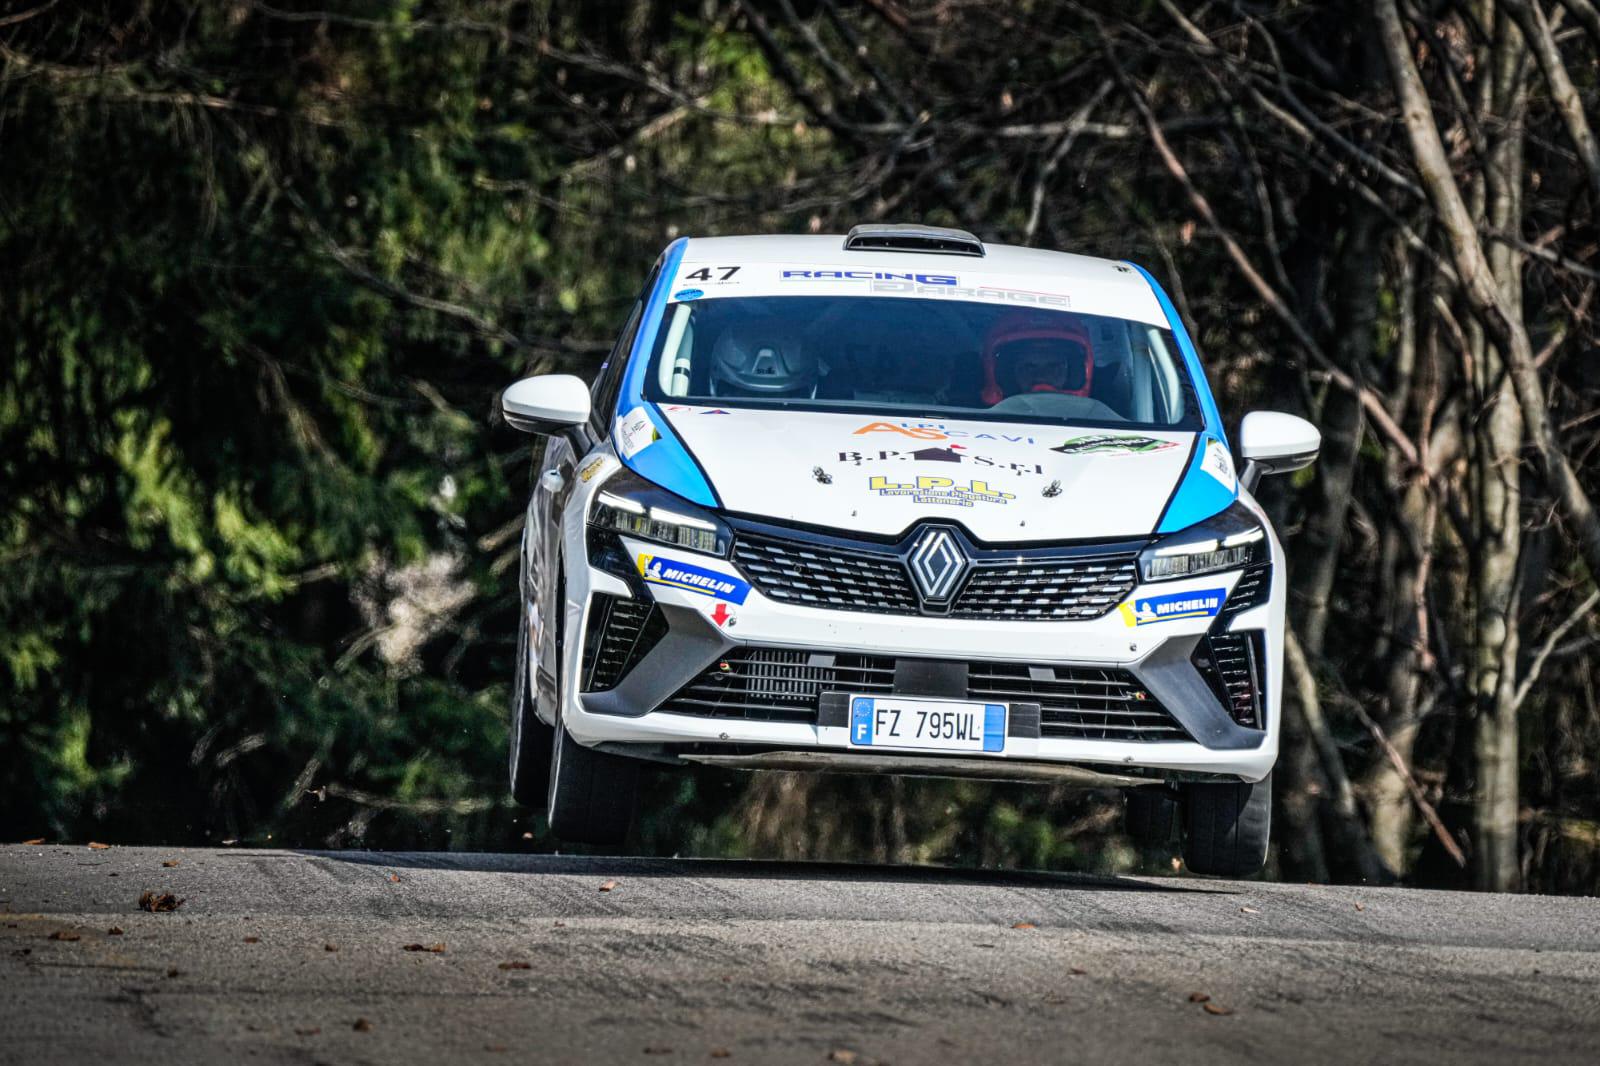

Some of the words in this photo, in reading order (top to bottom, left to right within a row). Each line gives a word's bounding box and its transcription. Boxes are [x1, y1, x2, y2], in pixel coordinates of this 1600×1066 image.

[685, 266, 741, 281] 47
[783, 270, 957, 286] RACING
[663, 568, 735, 594] MICHELIN
[1156, 597, 1218, 614] MICHELIN
[857, 724, 867, 740] F
[875, 709, 901, 737] FZ
[916, 711, 980, 741] 795WL
